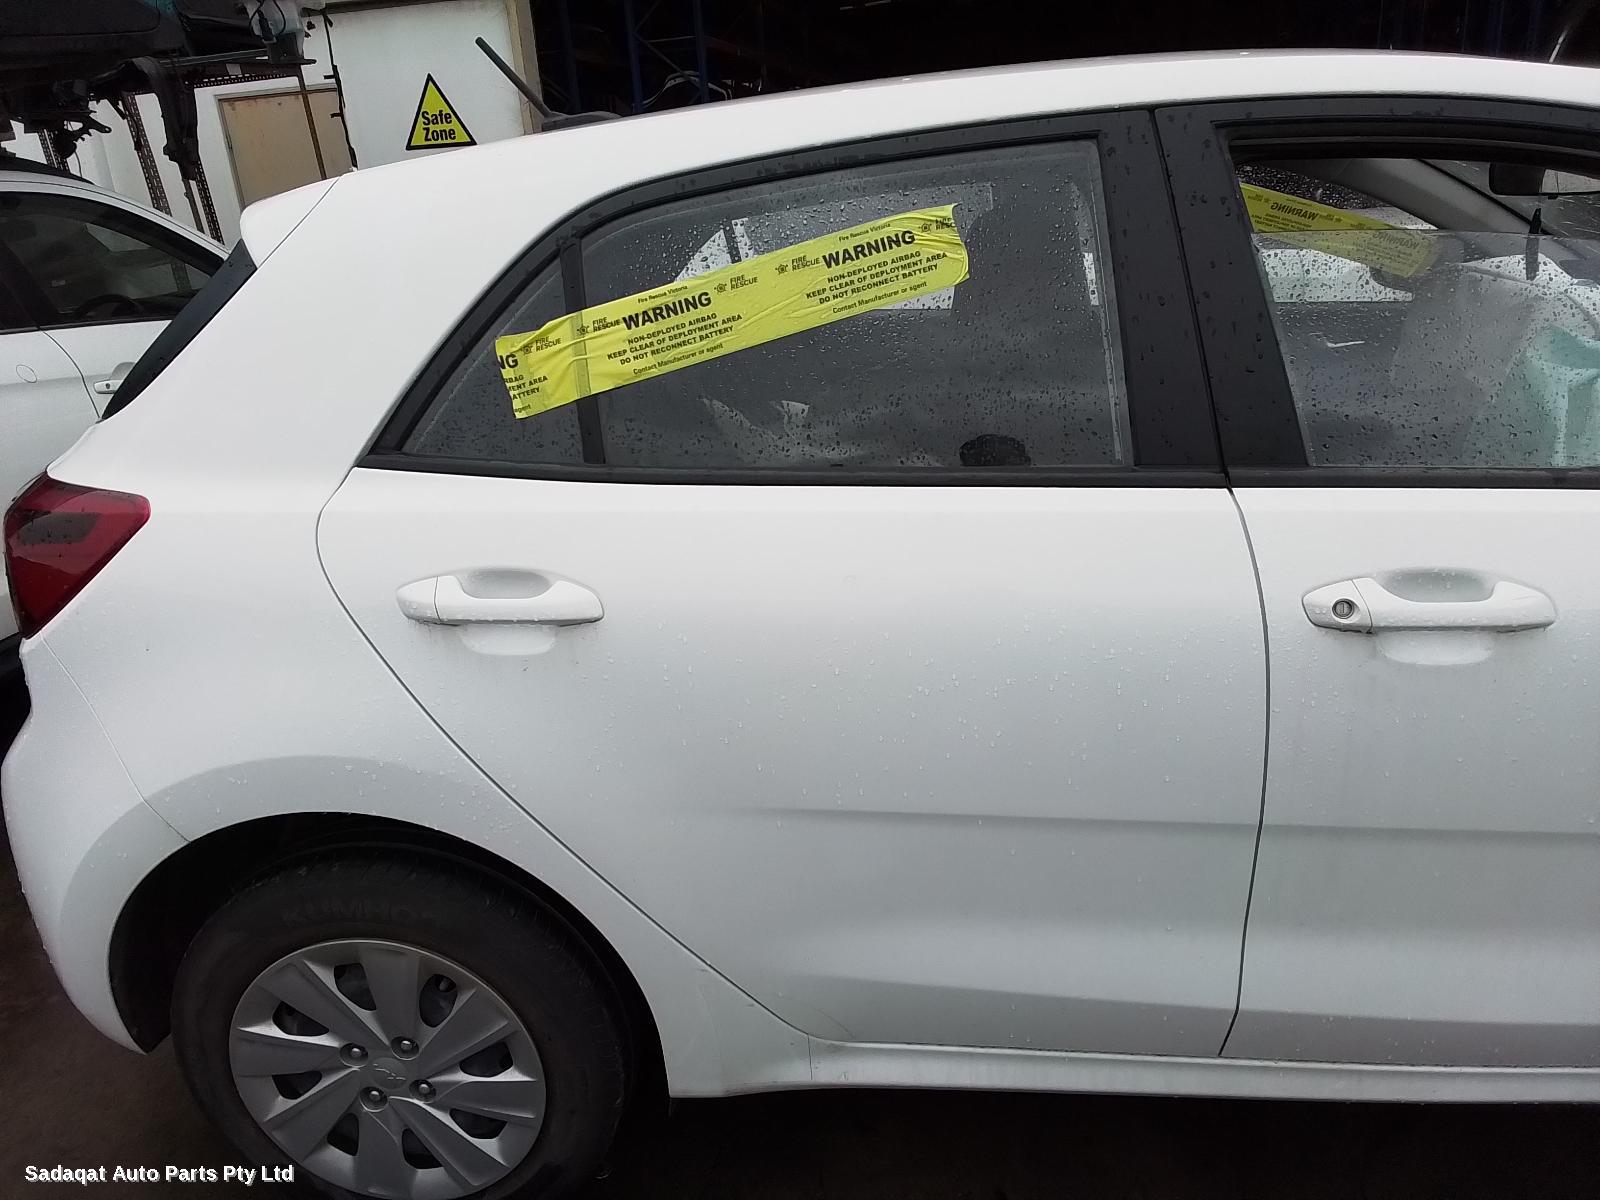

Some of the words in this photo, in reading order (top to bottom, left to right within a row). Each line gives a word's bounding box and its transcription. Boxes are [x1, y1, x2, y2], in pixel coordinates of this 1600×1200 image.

[421, 109, 453, 126] Safe
[422, 127, 457, 142] Zone
[850, 229, 869, 238] Rescue
[869, 223, 891, 232] Victoria
[822, 230, 916, 269] WARNING
[791, 255, 807, 265] FIRE
[791, 257, 821, 272] RESCUE
[827, 260, 889, 284] NON-DEPLOYED
[890, 250, 921, 265] AIRBAG
[730, 274, 745, 284] FIRE
[806, 288, 827, 299] KEEP
[829, 279, 855, 292] CLEAR
[857, 275, 868, 283] OF
[869, 259, 923, 280] DEPLOYMENT
[925, 252, 948, 264] AREA
[730, 277, 758, 290] RESCUE
[819, 296, 831, 304] DO
[832, 290, 849, 300] NOT
[850, 274, 900, 295] RECONNECT
[901, 263, 938, 280] BATTERY
[648, 292, 667, 300] Rescue
[667, 285, 688, 295] Victoria
[832, 301, 858, 314] Contact
[858, 288, 900, 307] Manufacturer
[909, 281, 927, 292] agent
[622, 291, 712, 331] WARNING
[592, 316, 607, 326] FIRE
[592, 319, 621, 333] RESCUE
[627, 322, 687, 345] NON-DEPLOYED
[688, 312, 717, 327] AIRBAG
[535, 336, 550, 346] FIRE
[607, 349, 628, 360] KEEP
[629, 341, 655, 353] CLEAR
[668, 321, 720, 342] DEPLOYMENT
[721, 313, 743, 326] AREA
[535, 338, 562, 352] RESCUE
[620, 357, 631, 366] DO
[633, 351, 649, 361] NOT
[650, 337, 698, 357] RECONNECT
[698, 325, 734, 341] BATTERY
[633, 363, 657, 375] Contact
[657, 351, 697, 368] Manufacturer
[706, 343, 724, 353] agent
[528, 375, 549, 387] AREA
[511, 387, 540, 400] ATTERY
